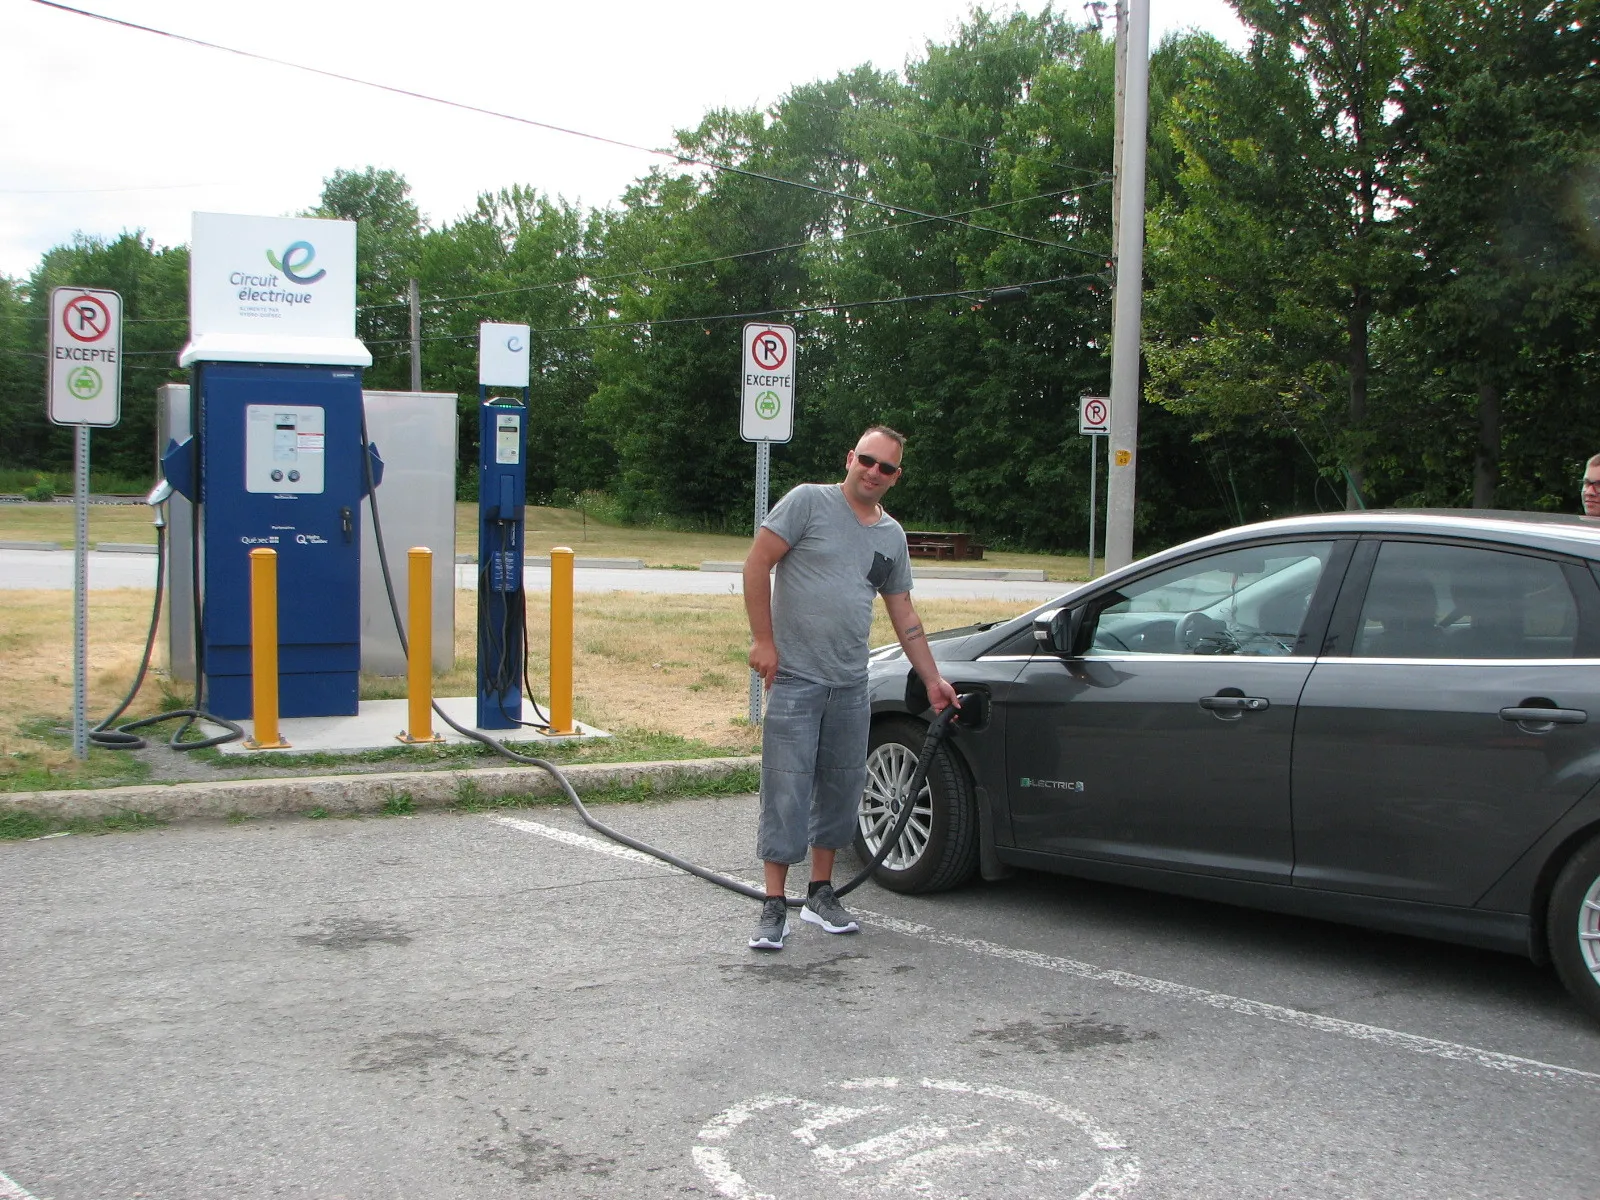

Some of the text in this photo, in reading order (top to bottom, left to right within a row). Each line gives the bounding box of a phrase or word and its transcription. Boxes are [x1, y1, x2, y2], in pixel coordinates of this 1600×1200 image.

[229, 271, 279, 287] Circuit
[238, 287, 313, 306] électrique
[55, 346, 117, 363] EXCEPTÉ
[746, 374, 791, 388] EXCEPTÉ
